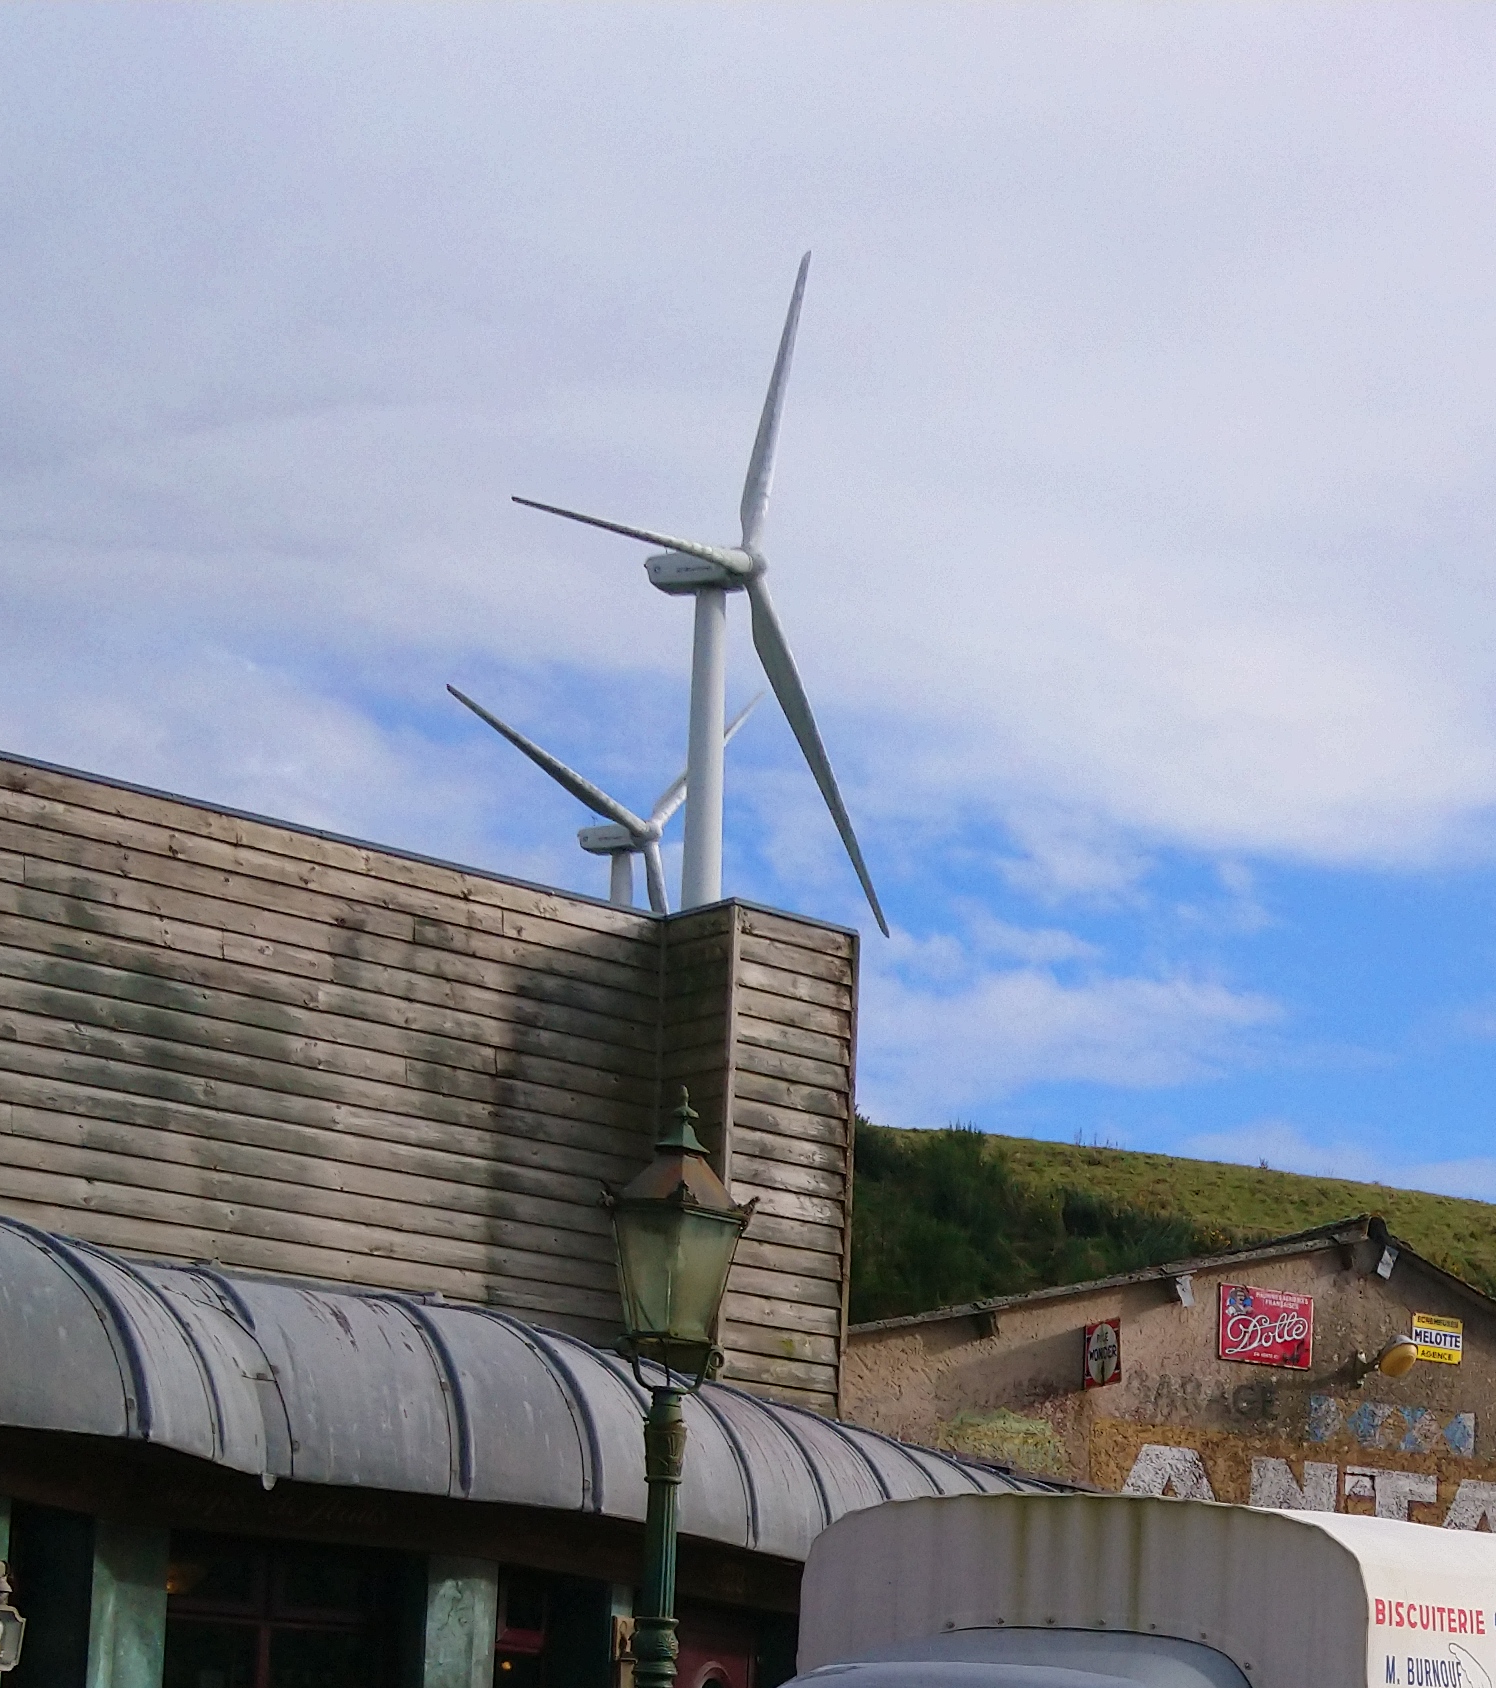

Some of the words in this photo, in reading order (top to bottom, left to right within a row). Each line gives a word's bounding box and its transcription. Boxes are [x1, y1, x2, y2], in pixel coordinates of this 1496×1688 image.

[1414, 1328, 1461, 1348] MELOTTE
[1089, 1344, 1117, 1361] WONDER
[1420, 1350, 1454, 1361] AGENCE
[1375, 1598, 1486, 1635] BISCUITERIE
[1385, 1655, 1401, 1685] M.
[1407, 1657, 1462, 1688] BURNOUF
